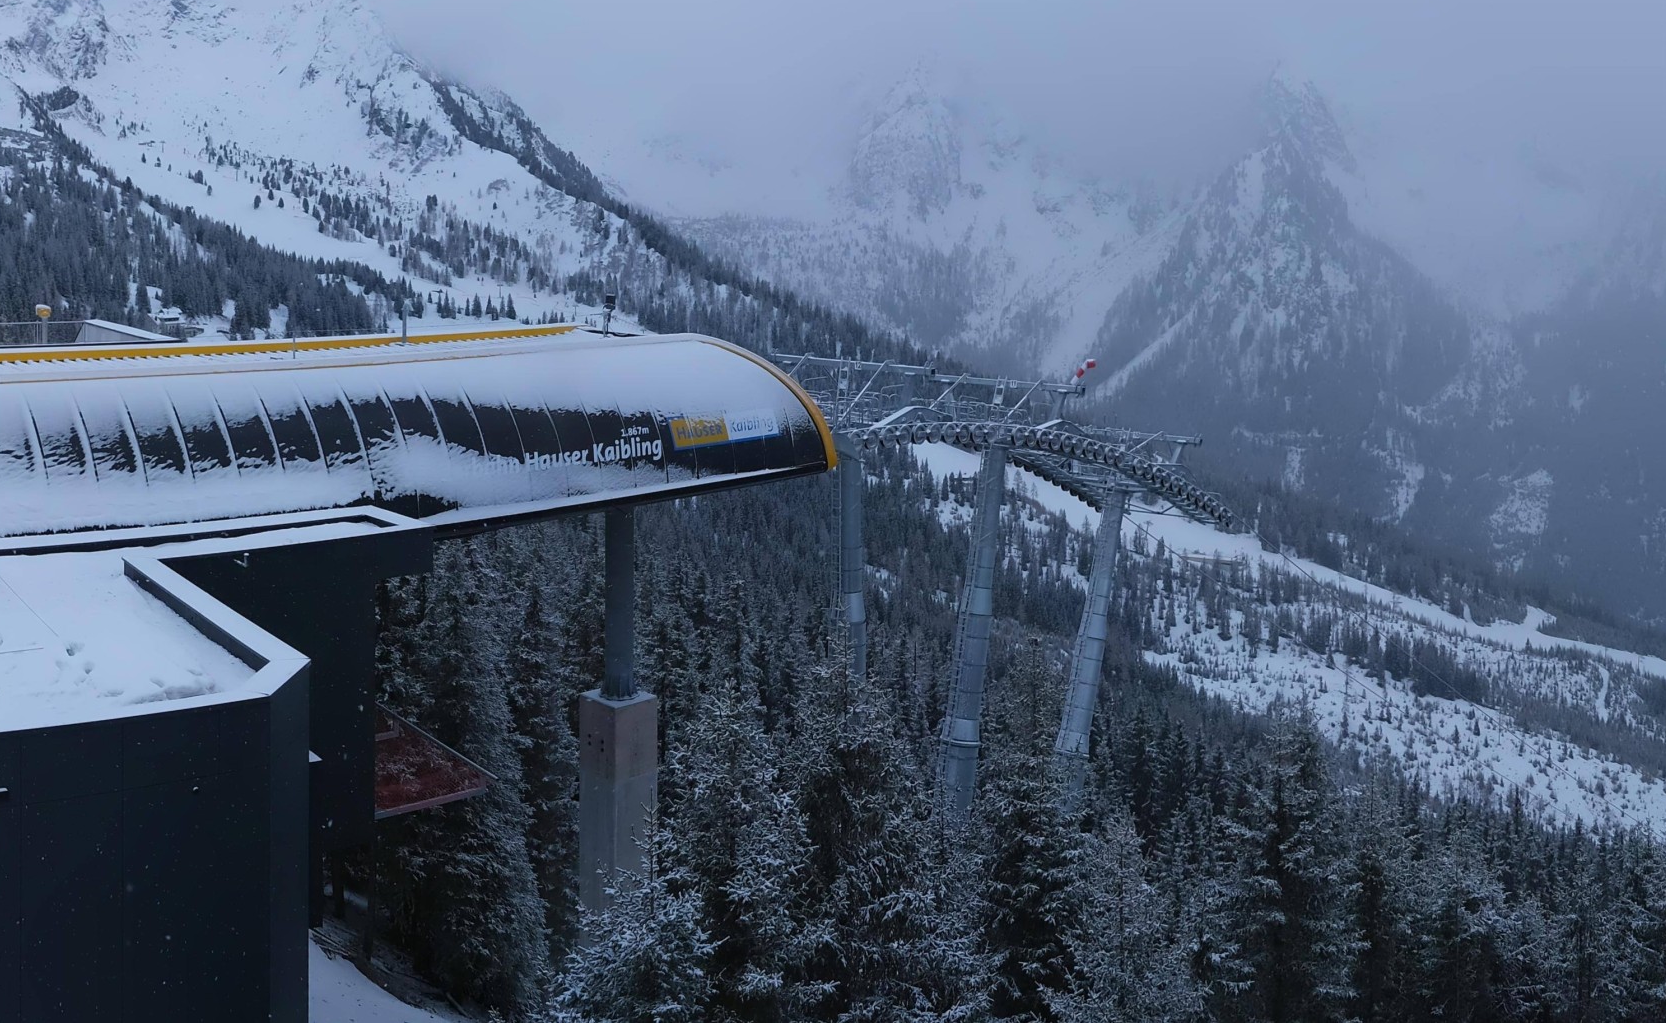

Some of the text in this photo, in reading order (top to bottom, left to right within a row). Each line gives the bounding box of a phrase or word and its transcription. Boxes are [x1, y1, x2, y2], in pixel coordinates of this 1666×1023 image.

[620, 426, 650, 438] 1.867m
[731, 416, 774, 432] Kaibling
[525, 449, 589, 471] Hauser
[593, 436, 663, 464] Kaibling
